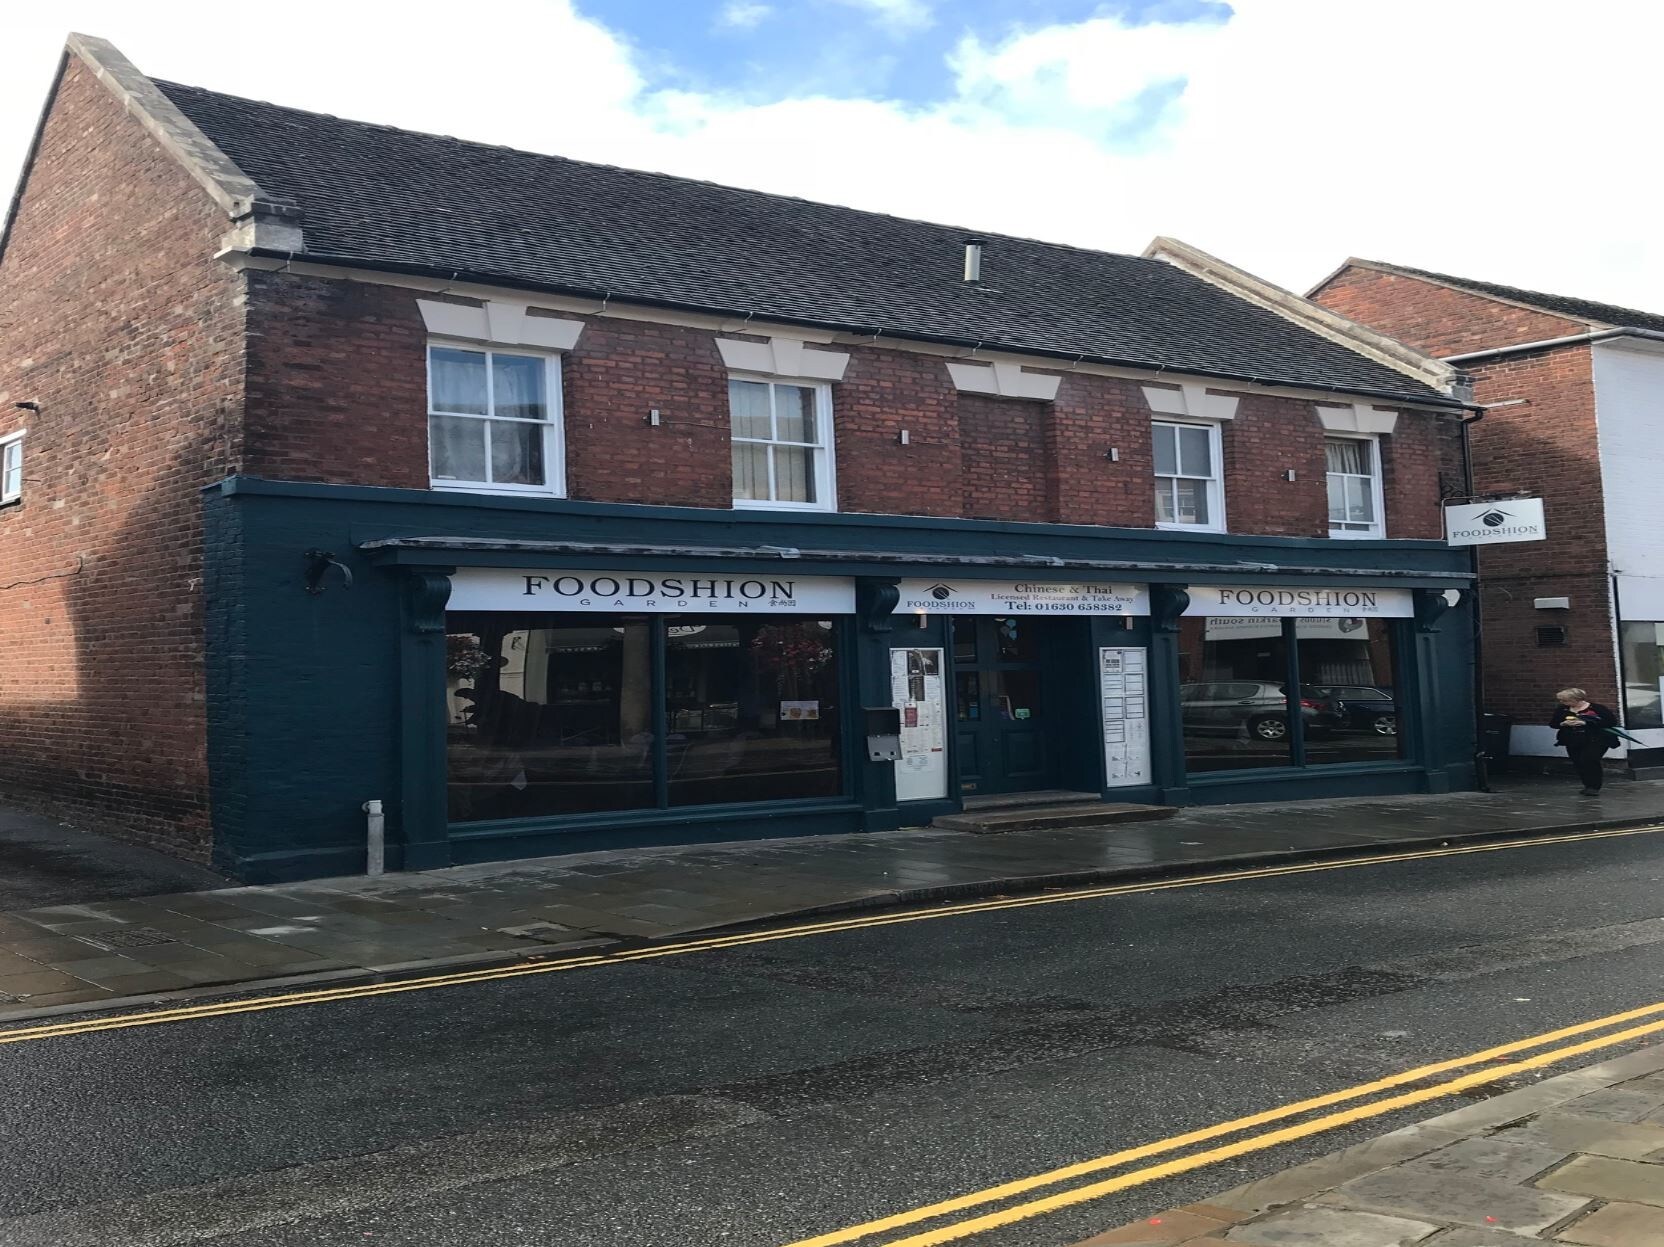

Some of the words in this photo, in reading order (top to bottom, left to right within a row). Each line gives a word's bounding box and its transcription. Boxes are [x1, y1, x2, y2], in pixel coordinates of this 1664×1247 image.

[1452, 525, 1538, 538] FOODSHION
[522, 575, 796, 599] FOODSHION
[1014, 583, 1065, 594] Chinese
[1069, 585, 1080, 594] &
[1082, 585, 1113, 595] Thai
[580, 598, 748, 608] GARDEN
[991, 593, 1031, 601] Licensed
[1113, 595, 1134, 604] Away
[1219, 589, 1377, 607] FOODSHION
[907, 600, 976, 608] FOODSHION
[1004, 601, 1032, 611] Tel:
[1035, 603, 1075, 611] 01630
[1078, 603, 1123, 612] 658382
